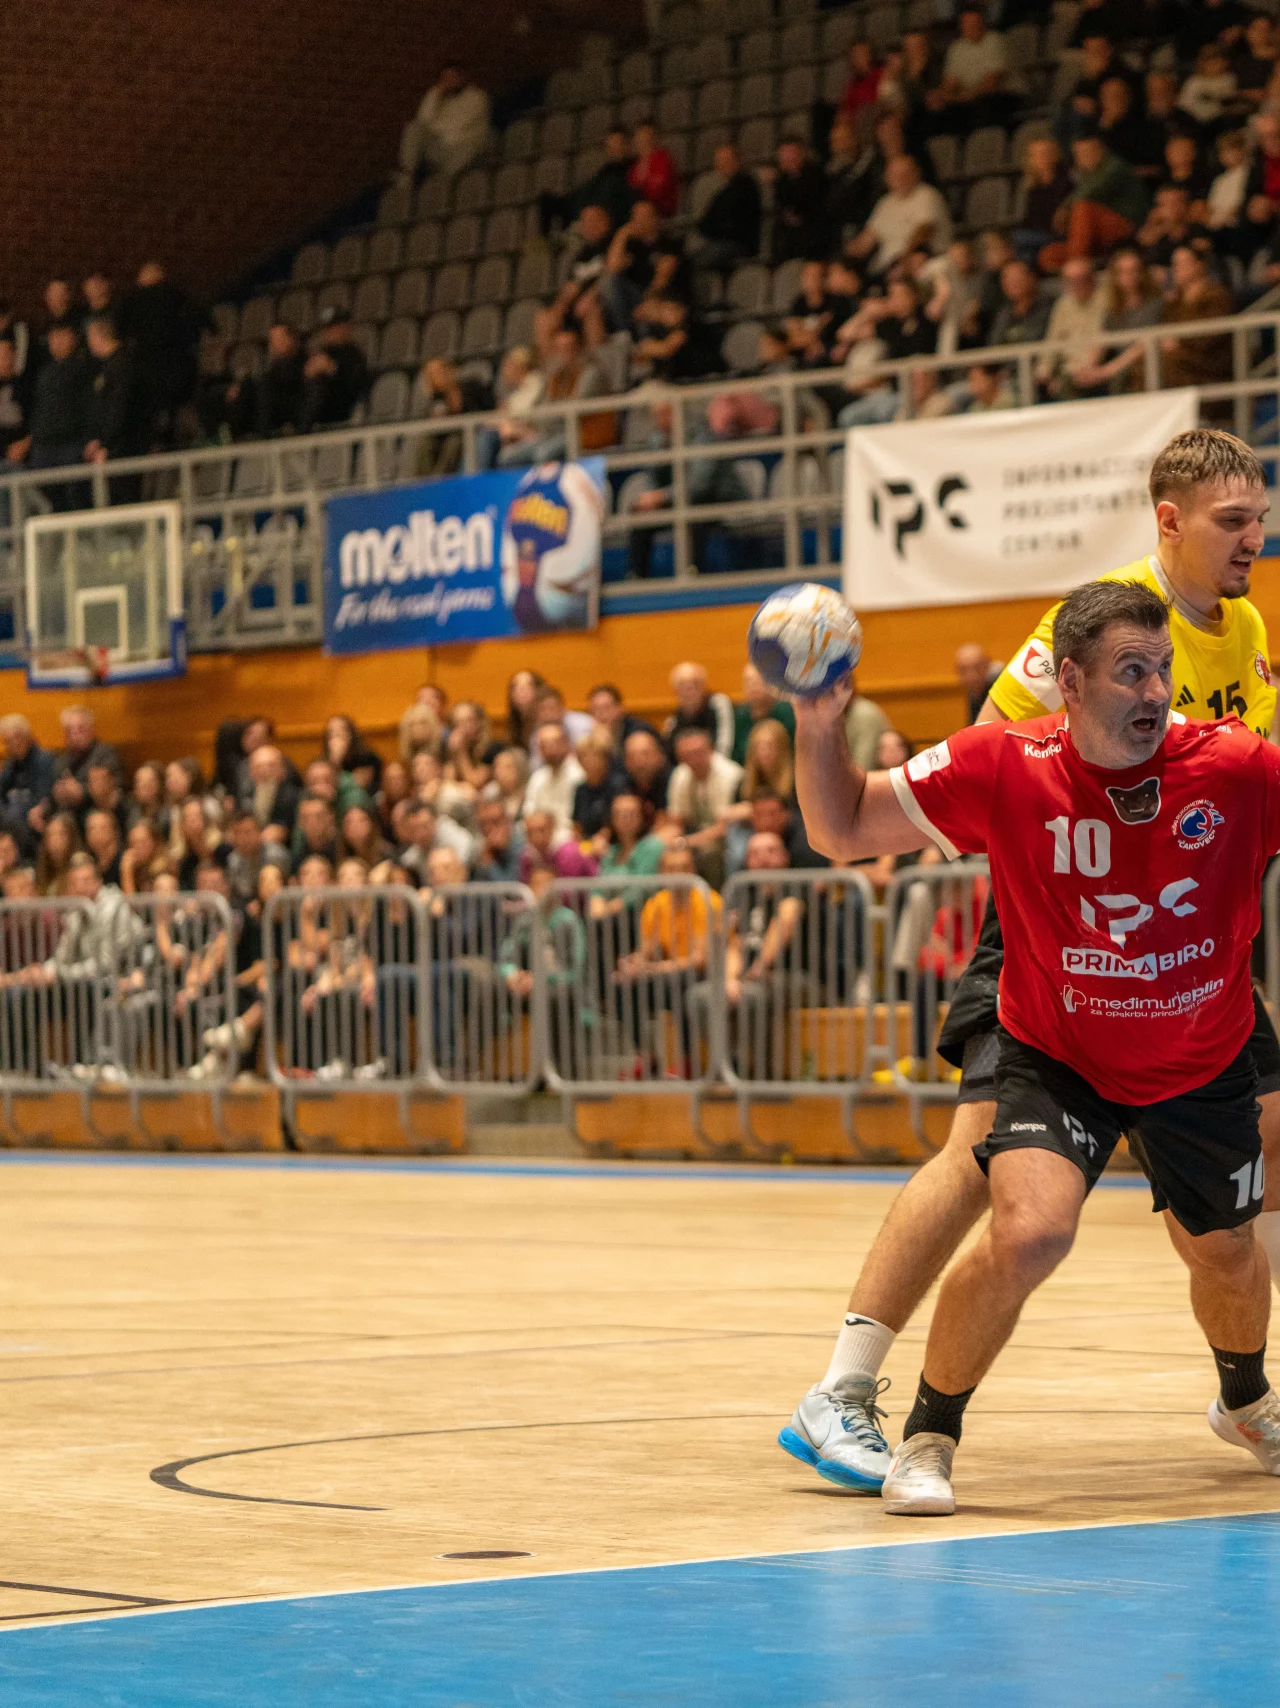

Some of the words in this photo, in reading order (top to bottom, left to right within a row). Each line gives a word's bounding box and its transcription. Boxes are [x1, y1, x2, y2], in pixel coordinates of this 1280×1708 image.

[870, 472, 970, 562] IPC
[340, 509, 495, 589] molten
[1207, 681, 1247, 719] 15
[1024, 743, 1062, 759] Kempa
[1045, 816, 1111, 877] 10
[1080, 877, 1199, 950] IPC
[1090, 977, 1225, 1011] međimurjeplin
[1090, 1008, 1103, 1016] za
[1105, 1010, 1148, 1018] opskrbu
[1150, 1003, 1196, 1019] prirodnim
[1010, 1121, 1047, 1133] Kempa
[1229, 1151, 1265, 1209] 10
